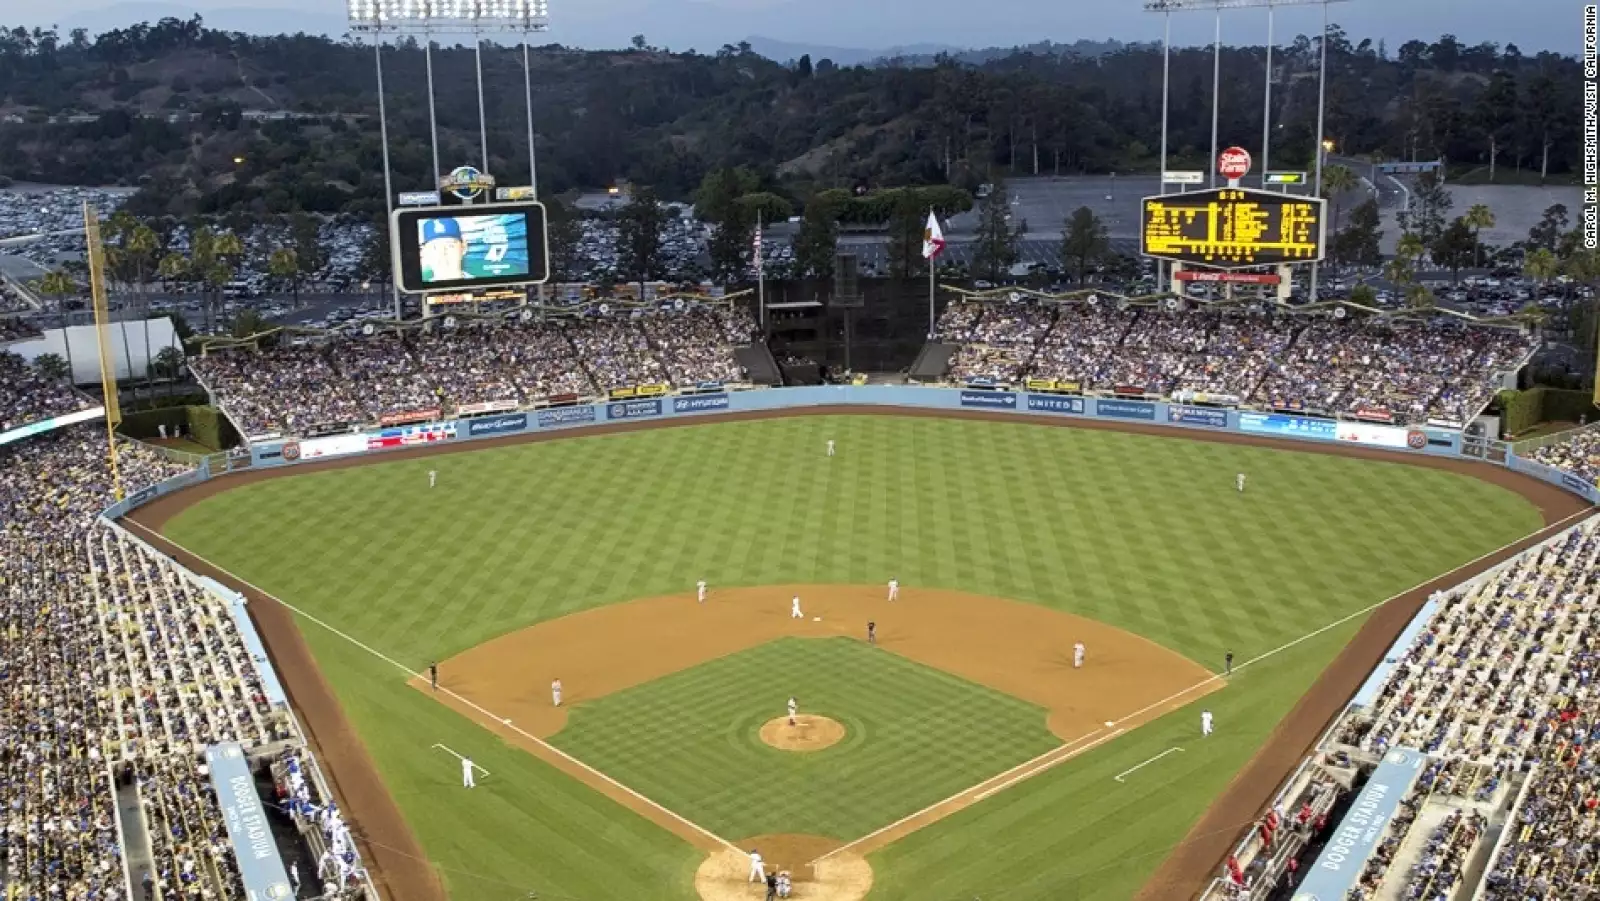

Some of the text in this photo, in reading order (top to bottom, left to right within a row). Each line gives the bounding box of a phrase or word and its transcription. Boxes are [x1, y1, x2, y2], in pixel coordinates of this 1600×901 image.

[1223, 153, 1246, 163] State
[1221, 162, 1246, 173] Farm
[691, 398, 729, 408] HYUNDAI
[1029, 399, 1071, 410] UNITED
[229, 775, 257, 815] DODGER
[243, 814, 273, 860] STADIUM
[1321, 783, 1390, 872] DODGER STADIUM
